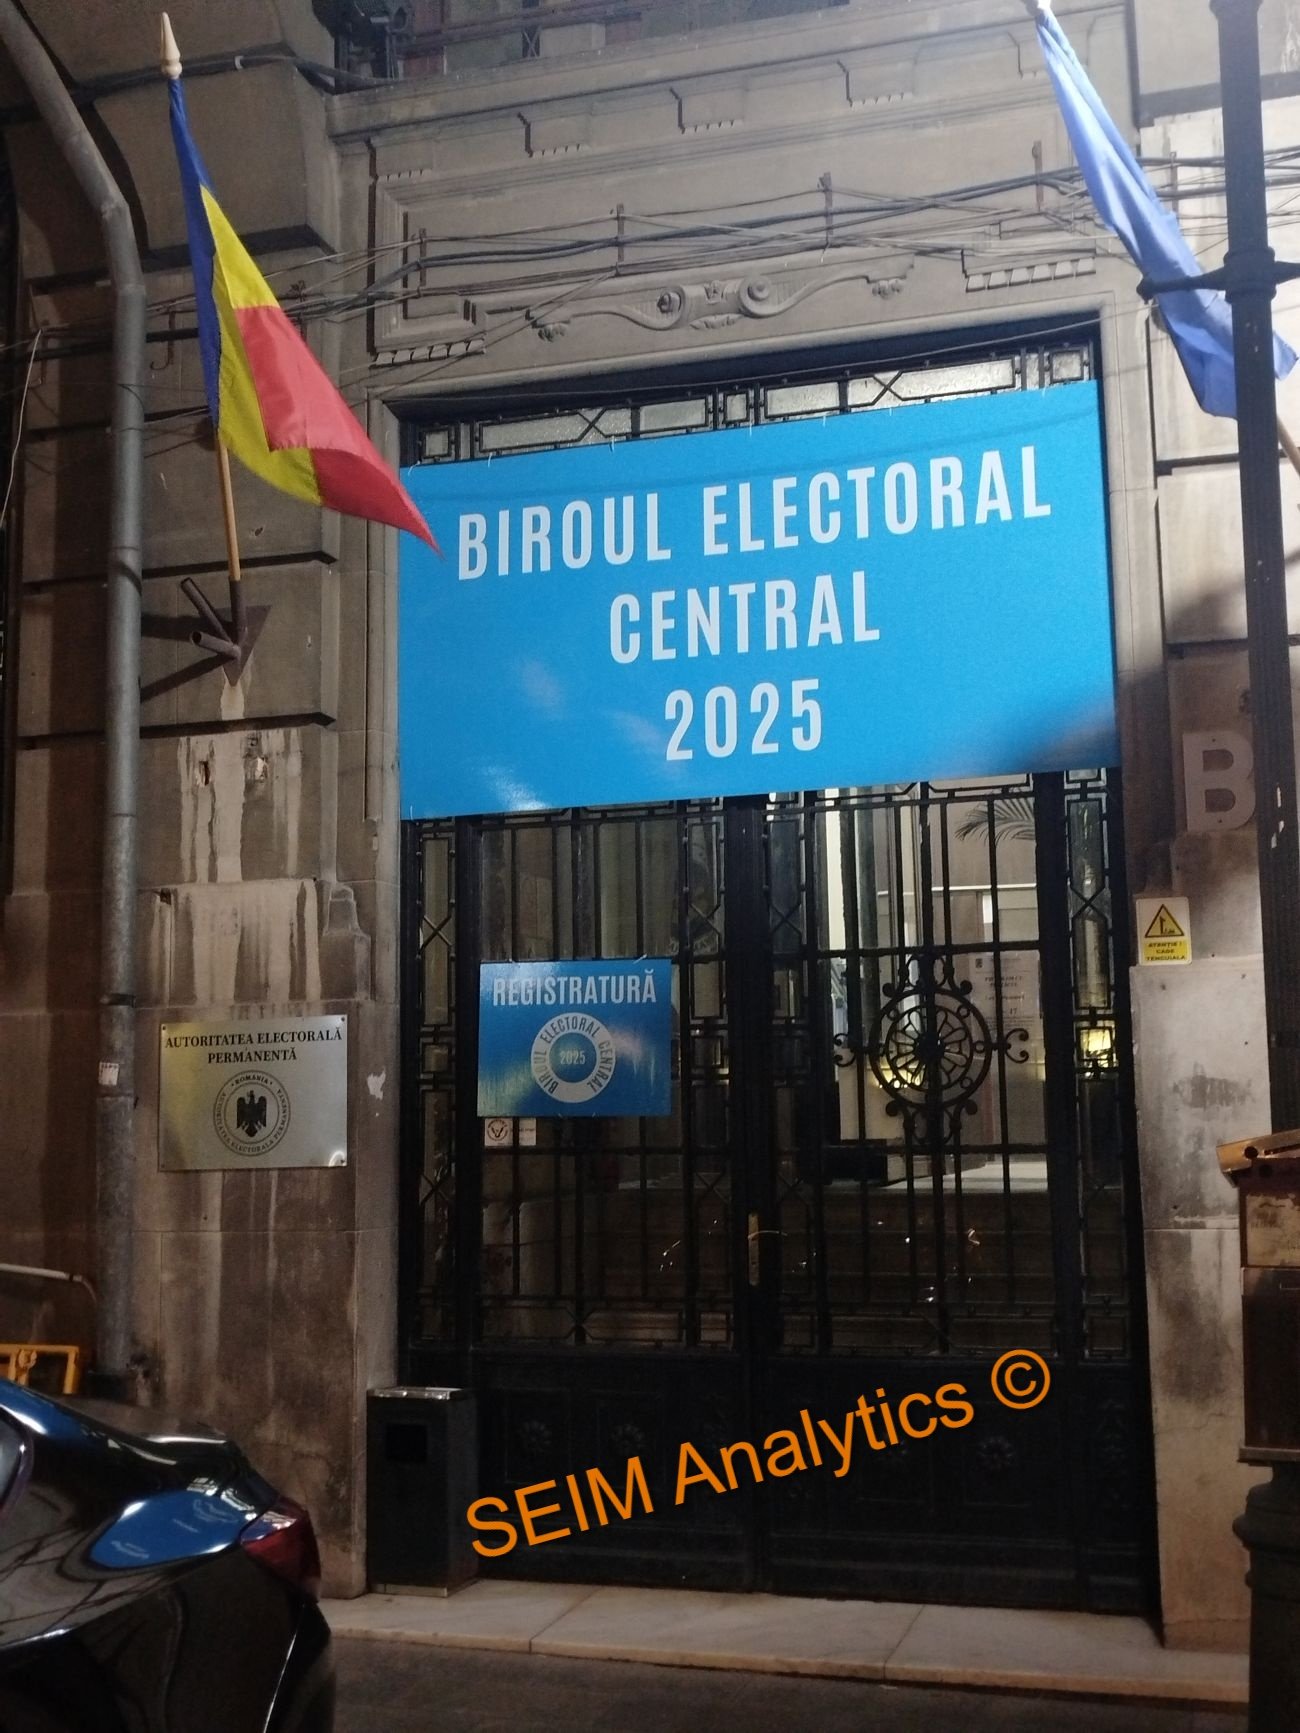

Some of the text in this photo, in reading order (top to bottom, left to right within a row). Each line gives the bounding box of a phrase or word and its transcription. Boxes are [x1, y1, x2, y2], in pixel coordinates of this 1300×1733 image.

[458, 446, 1051, 580] BIROUL ELECTORAL
[609, 571, 880, 664] CENTRAL
[664, 678, 822, 761] 2025
[1182, 732, 1256, 833] B
[492, 968, 657, 1007] REGISTRATURĂ
[165, 1027, 343, 1049] AUTORITATEA ELECTORALĂ
[208, 1046, 297, 1065] PERMANENTĂ
[533, 1016, 614, 1095] BIROUL ELECTORAL CENTRAL
[560, 1049, 586, 1065] 2025
